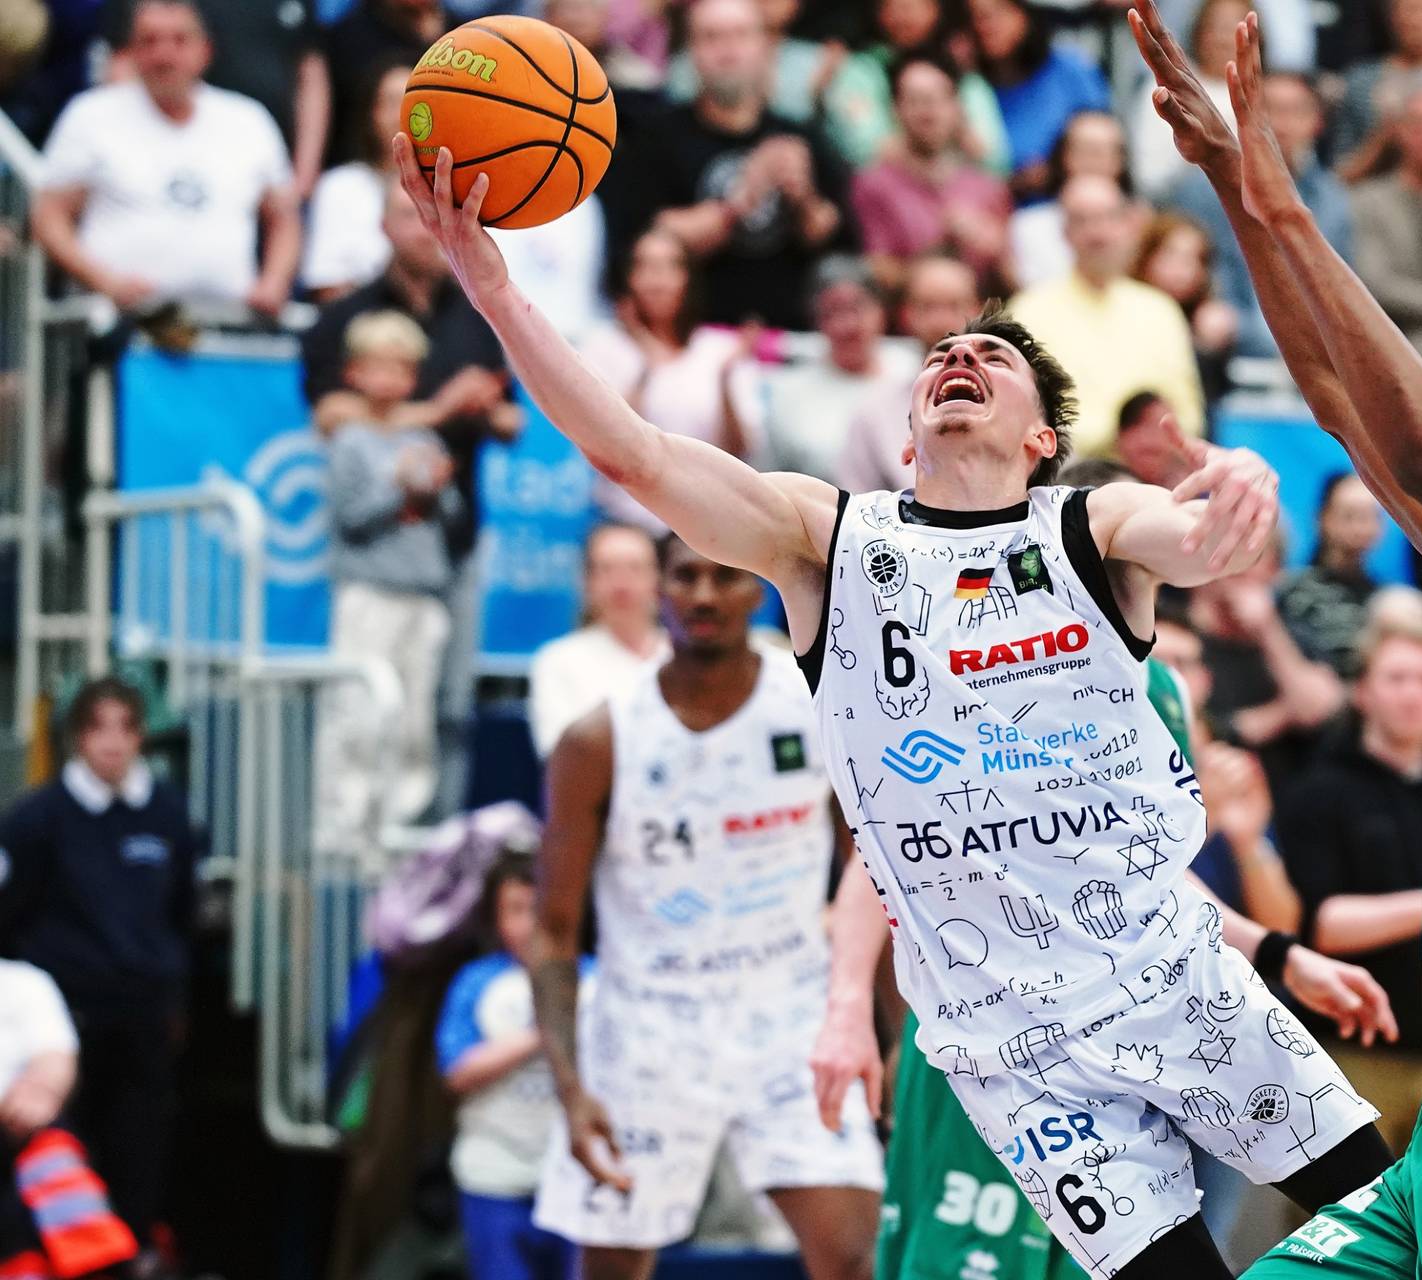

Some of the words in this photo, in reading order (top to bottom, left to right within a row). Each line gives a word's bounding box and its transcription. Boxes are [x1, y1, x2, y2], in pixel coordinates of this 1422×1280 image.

[880, 619, 917, 689] 6
[949, 623, 1089, 677] RATIO
[965, 655, 1092, 692] nternehmensgruppe
[977, 721, 1099, 751] Staerke
[981, 747, 1074, 775] Münsr
[639, 816, 697, 868] 24
[961, 801, 1131, 858] ATRUVIA
[1025, 1110, 1104, 1163] ISR
[935, 1170, 1019, 1237] 30
[1054, 1172, 1108, 1236] 6
